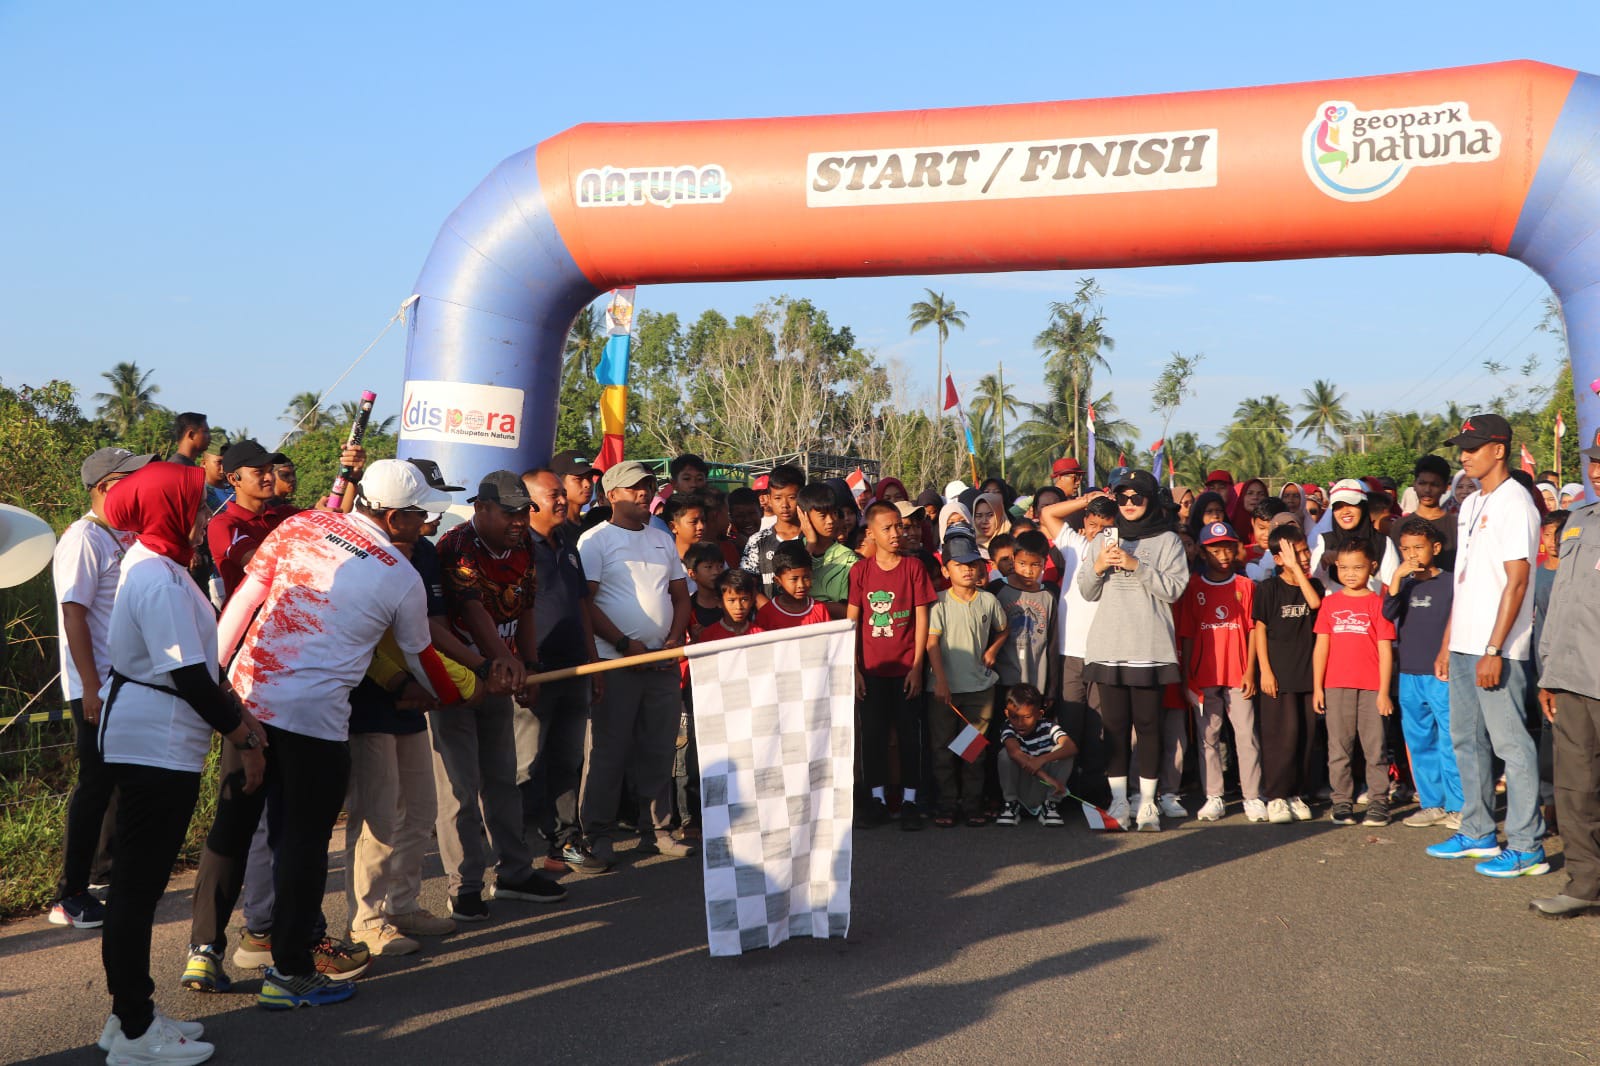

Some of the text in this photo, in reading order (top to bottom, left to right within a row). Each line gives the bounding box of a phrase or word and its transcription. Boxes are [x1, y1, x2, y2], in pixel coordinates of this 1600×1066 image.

[1353, 108, 1462, 137] geopark
[1350, 128, 1493, 164] natuna
[812, 134, 1210, 194] START / FINISH
[450, 428, 516, 440] Kabupaten Natuna
[325, 533, 369, 560] NATUNA
[1196, 591, 1206, 606] 8
